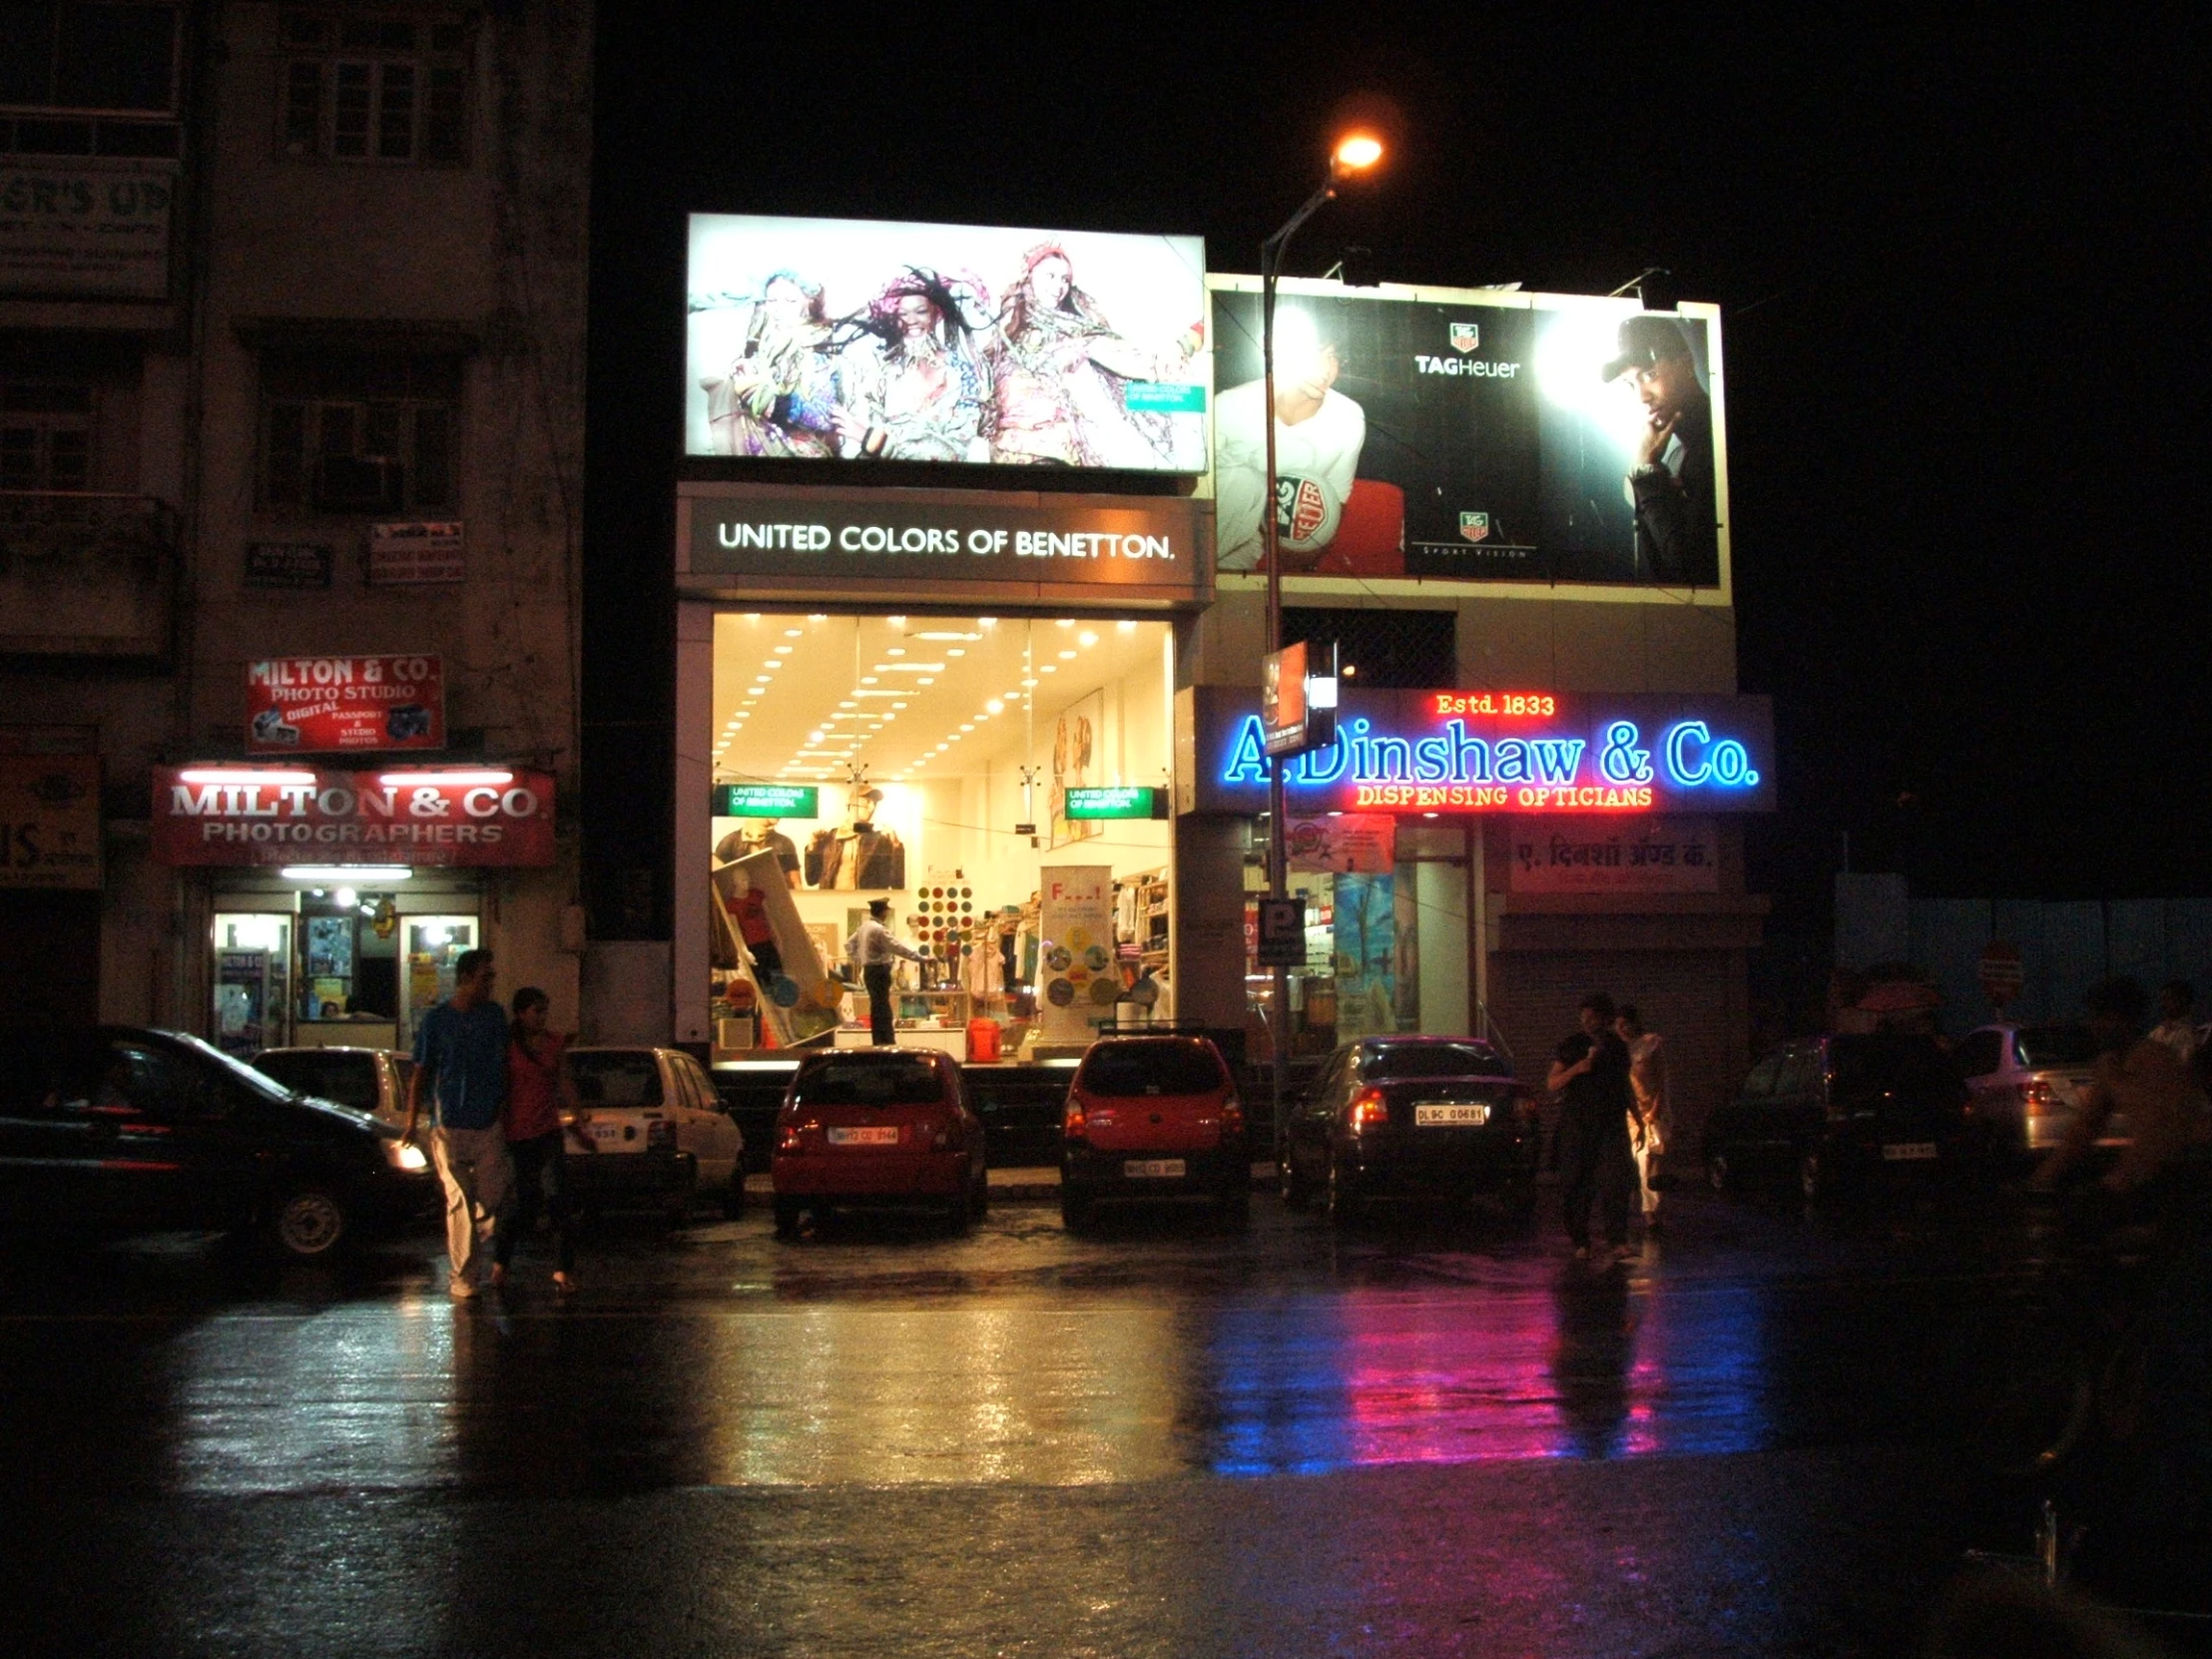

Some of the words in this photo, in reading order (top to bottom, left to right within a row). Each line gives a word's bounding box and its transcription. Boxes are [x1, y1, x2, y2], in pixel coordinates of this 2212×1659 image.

[719, 523, 831, 551] UNITED
[839, 526, 960, 554] COLORS
[967, 529, 1008, 555] OF
[1015, 530, 1175, 560] BENETTON.
[249, 660, 353, 686] MILTON
[363, 659, 383, 683] &
[392, 657, 437, 681] CO.
[272, 686, 339, 702] PHOTO
[344, 684, 416, 701] STUDIO
[286, 701, 340, 722] DIGITAL
[331, 711, 382, 720] PASSPORT
[1502, 695, 1555, 717] 1833
[1601, 720, 1652, 783] &
[1665, 720, 1760, 787] Co.
[170, 785, 398, 818] MILTON
[409, 787, 450, 818] &
[1357, 785, 1508, 807] DISPENSING
[1518, 787, 1652, 808] OPTICIANS
[202, 823, 503, 842] PHOTOGRAPHERS
[1265, 903, 1297, 939] P
